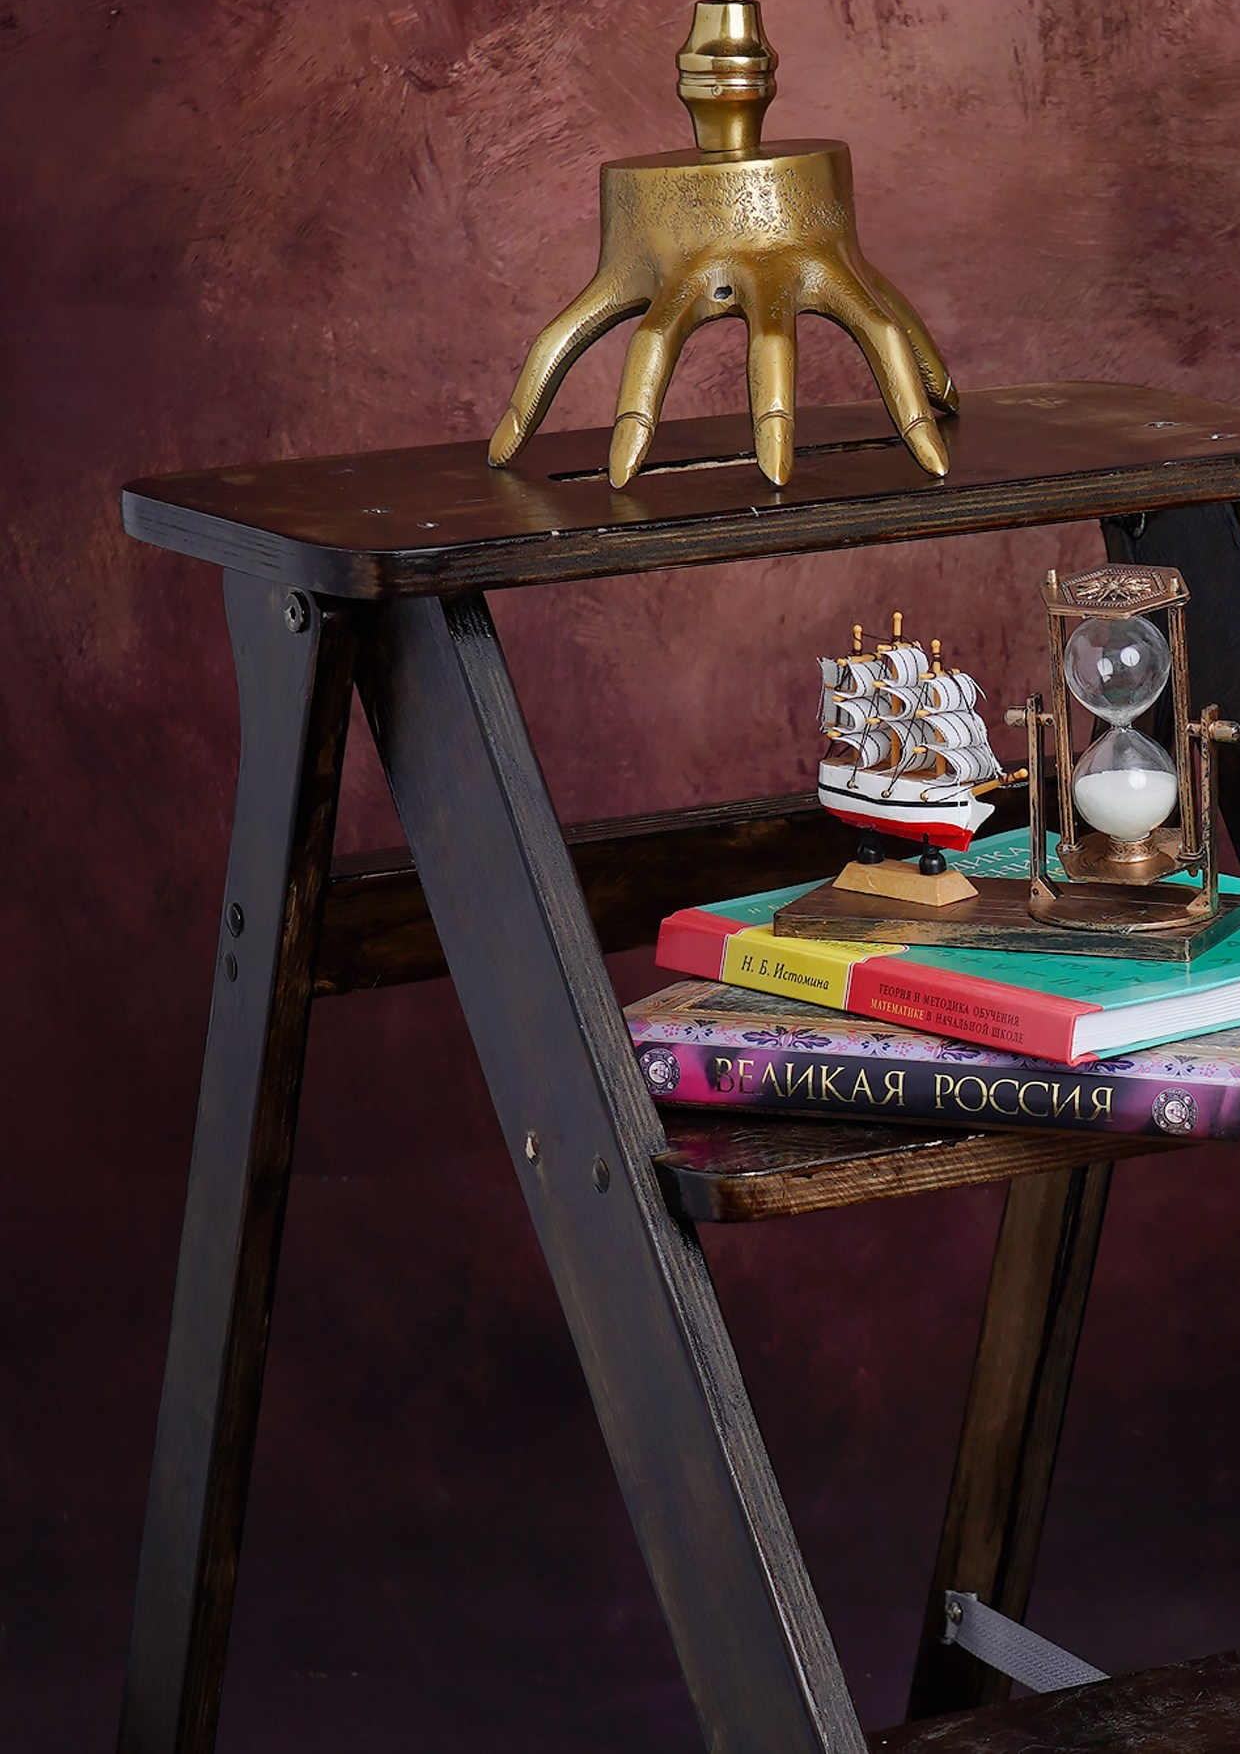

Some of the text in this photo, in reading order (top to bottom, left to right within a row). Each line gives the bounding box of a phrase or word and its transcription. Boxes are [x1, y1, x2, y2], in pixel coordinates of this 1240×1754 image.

[741, 955, 831, 991] Н. Б. Истомина
[870, 997, 1024, 1045] МАТЕМАТИКЕ В НАЧАЛЬНОЙ ШКОЛЕ
[878, 982, 1020, 1027] ТЕОРИЯ И МЕТОДИКА ОБУЧЕНИЯ
[713, 1057, 1114, 1123] ВЕЛИКАЯ РОССИЯ
